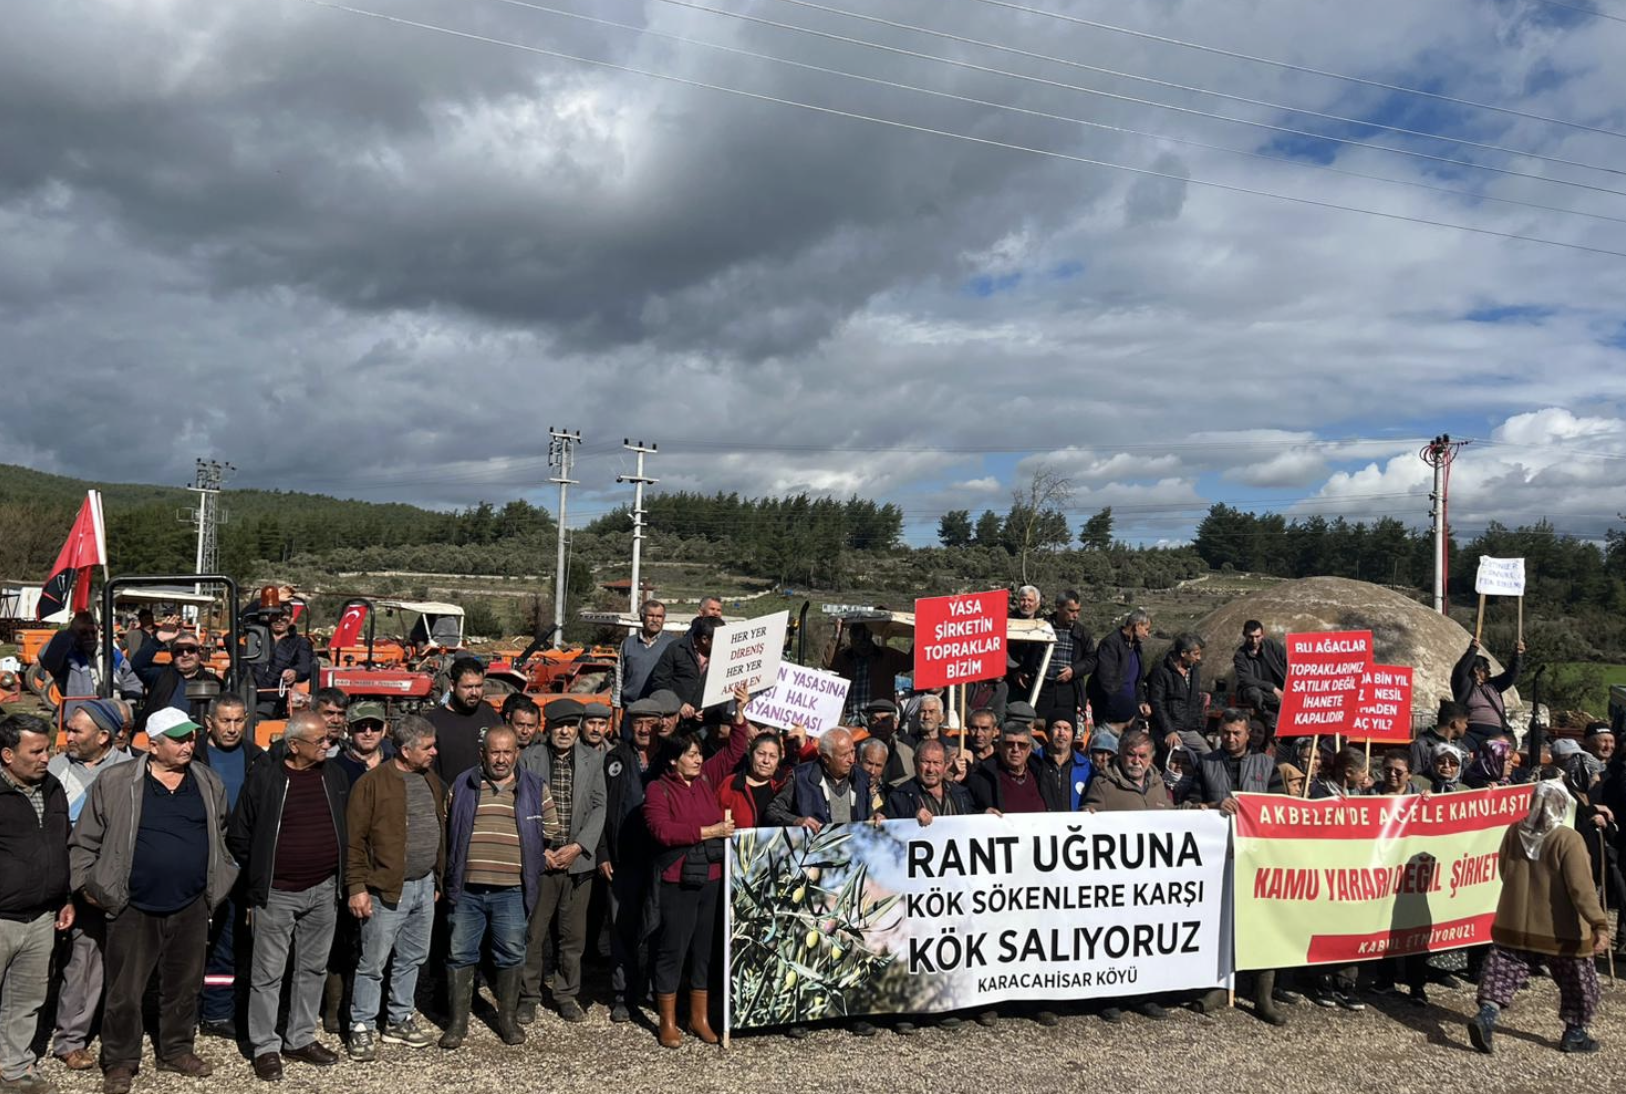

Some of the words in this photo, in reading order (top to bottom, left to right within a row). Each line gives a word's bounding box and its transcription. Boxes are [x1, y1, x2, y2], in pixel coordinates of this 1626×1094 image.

[949, 599, 982, 616] YASA
[731, 631, 748, 644] HER
[751, 626, 767, 639] YER
[935, 616, 993, 641] ŞİRKETİN
[730, 642, 765, 660] DİRENİŞ
[924, 636, 1001, 661] TOPRAKLAR
[726, 664, 744, 678] HER
[746, 659, 762, 672] YER
[946, 658, 982, 679] BİZİM
[1290, 662, 1365, 676] TOPRAKLARIMIZ
[792, 670, 846, 699] YASASINA
[1292, 679, 1331, 692] SATILIK
[1332, 676, 1356, 690] DEĞİL
[1374, 671, 1392, 685] BİN
[1394, 674, 1409, 687] YIL
[786, 689, 819, 711] HALK
[1303, 694, 1344, 708] İHANETE
[1374, 687, 1403, 701] NESİL
[745, 700, 823, 732] AYANIŞMASI
[1294, 711, 1344, 725] KAPALIDIR
[1353, 717, 1369, 730] AÇ
[1371, 718, 1393, 731] YIL?
[1378, 805, 1444, 826] ACELE
[1449, 793, 1531, 821] KAMULAŞTI
[907, 836, 1019, 879] RANT
[1033, 825, 1203, 873] UĞRUNA
[1254, 867, 1320, 901] KAMU
[1324, 867, 1393, 901] YARARI
[1393, 855, 1441, 895] DEĞİL
[907, 889, 965, 919] KÖK
[972, 881, 1125, 915] SÖKENLERE
[1133, 880, 1204, 908] KARŞI
[908, 927, 988, 973] KÖK
[998, 919, 1202, 964] SALIYORUZ
[1357, 938, 1400, 954] KABUL
[977, 970, 1092, 993] KARACAHİSAR
[1096, 965, 1138, 988] KÖYÜ
